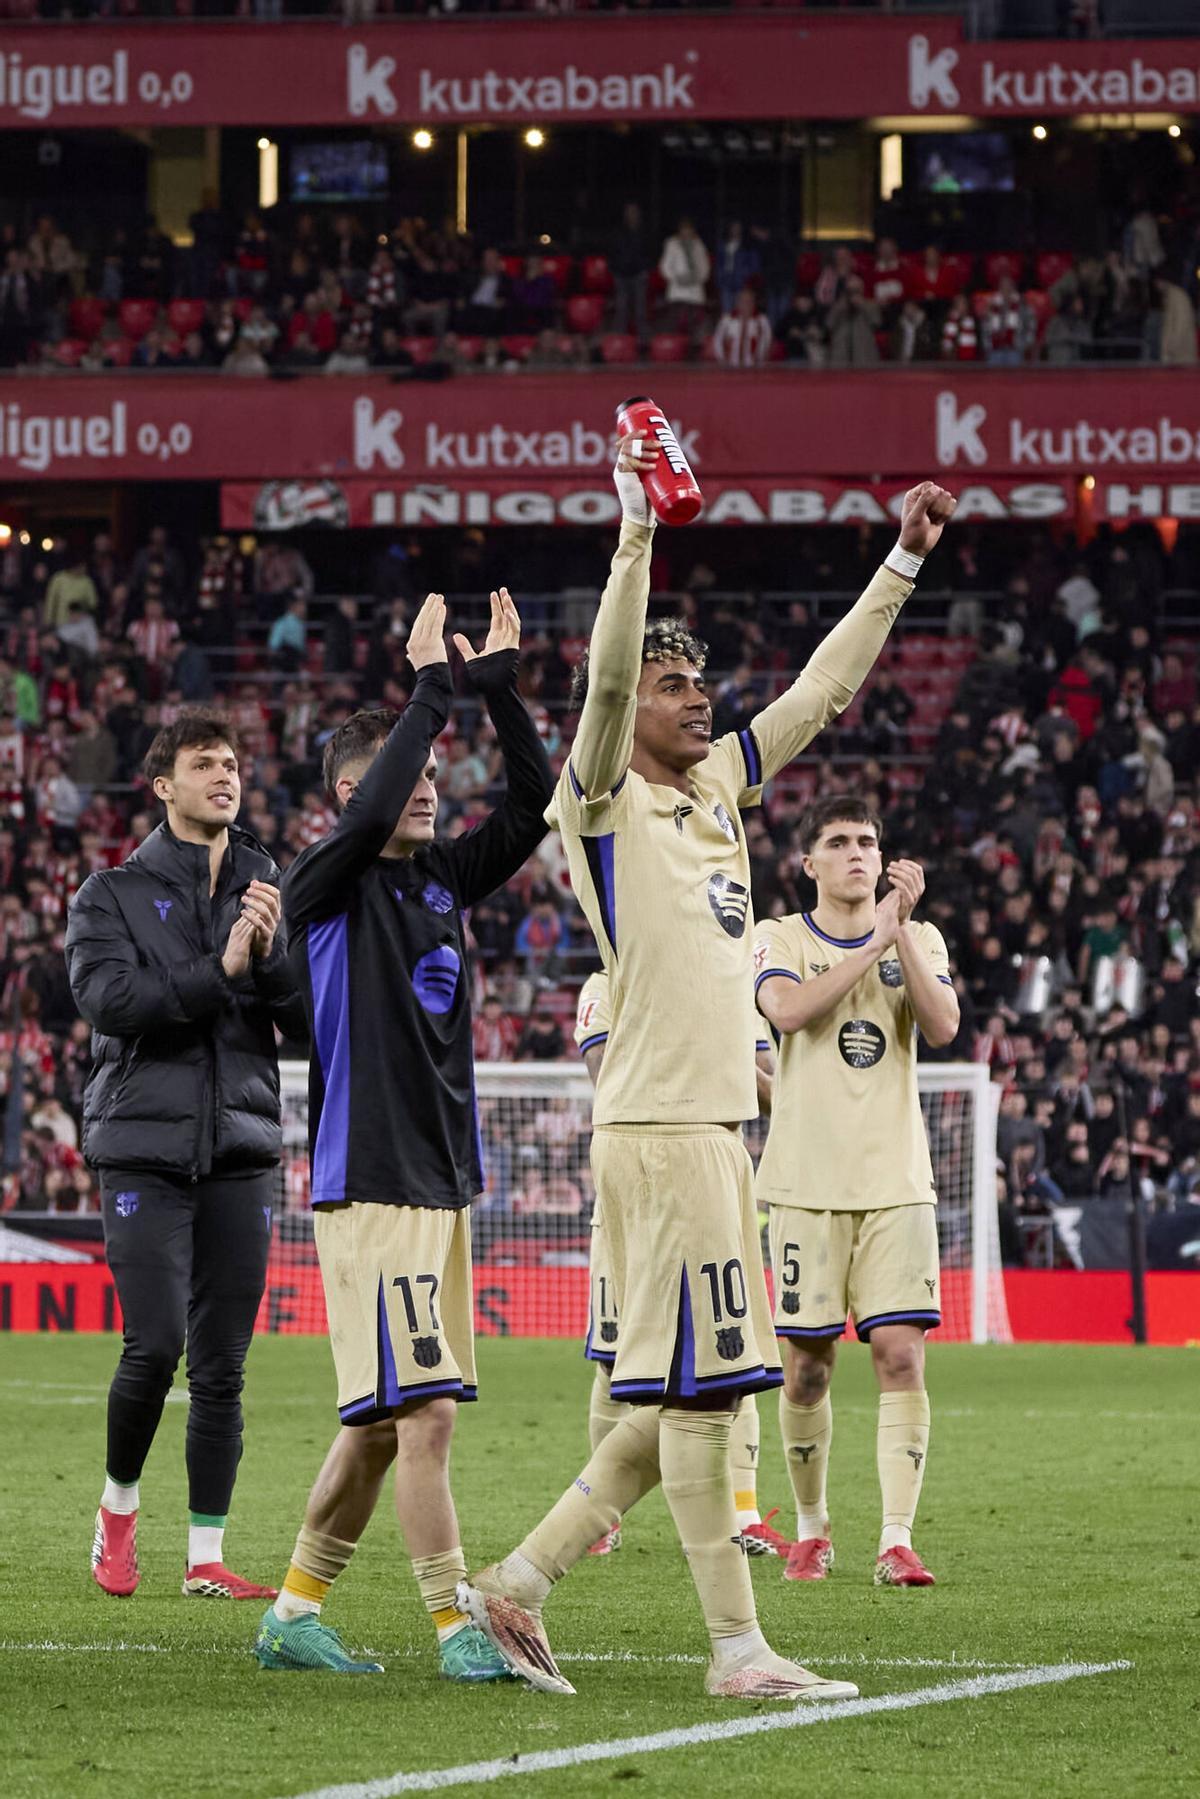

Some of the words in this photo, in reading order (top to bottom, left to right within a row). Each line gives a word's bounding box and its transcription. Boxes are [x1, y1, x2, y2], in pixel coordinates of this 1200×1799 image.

[0, 50, 129, 120] iguel
[419, 63, 694, 114] kutxabank
[982, 58, 1200, 107] kutxaba
[0, 400, 127, 472] iguel
[426, 420, 701, 468] kutxabk
[1009, 416, 1200, 465] kutxab
[370, 483, 621, 525] IÑIGO
[698, 483, 1068, 523] ABAAS
[783, 1243, 800, 1286] 5
[392, 1274, 439, 1333] 17
[700, 1258, 748, 1323] 10
